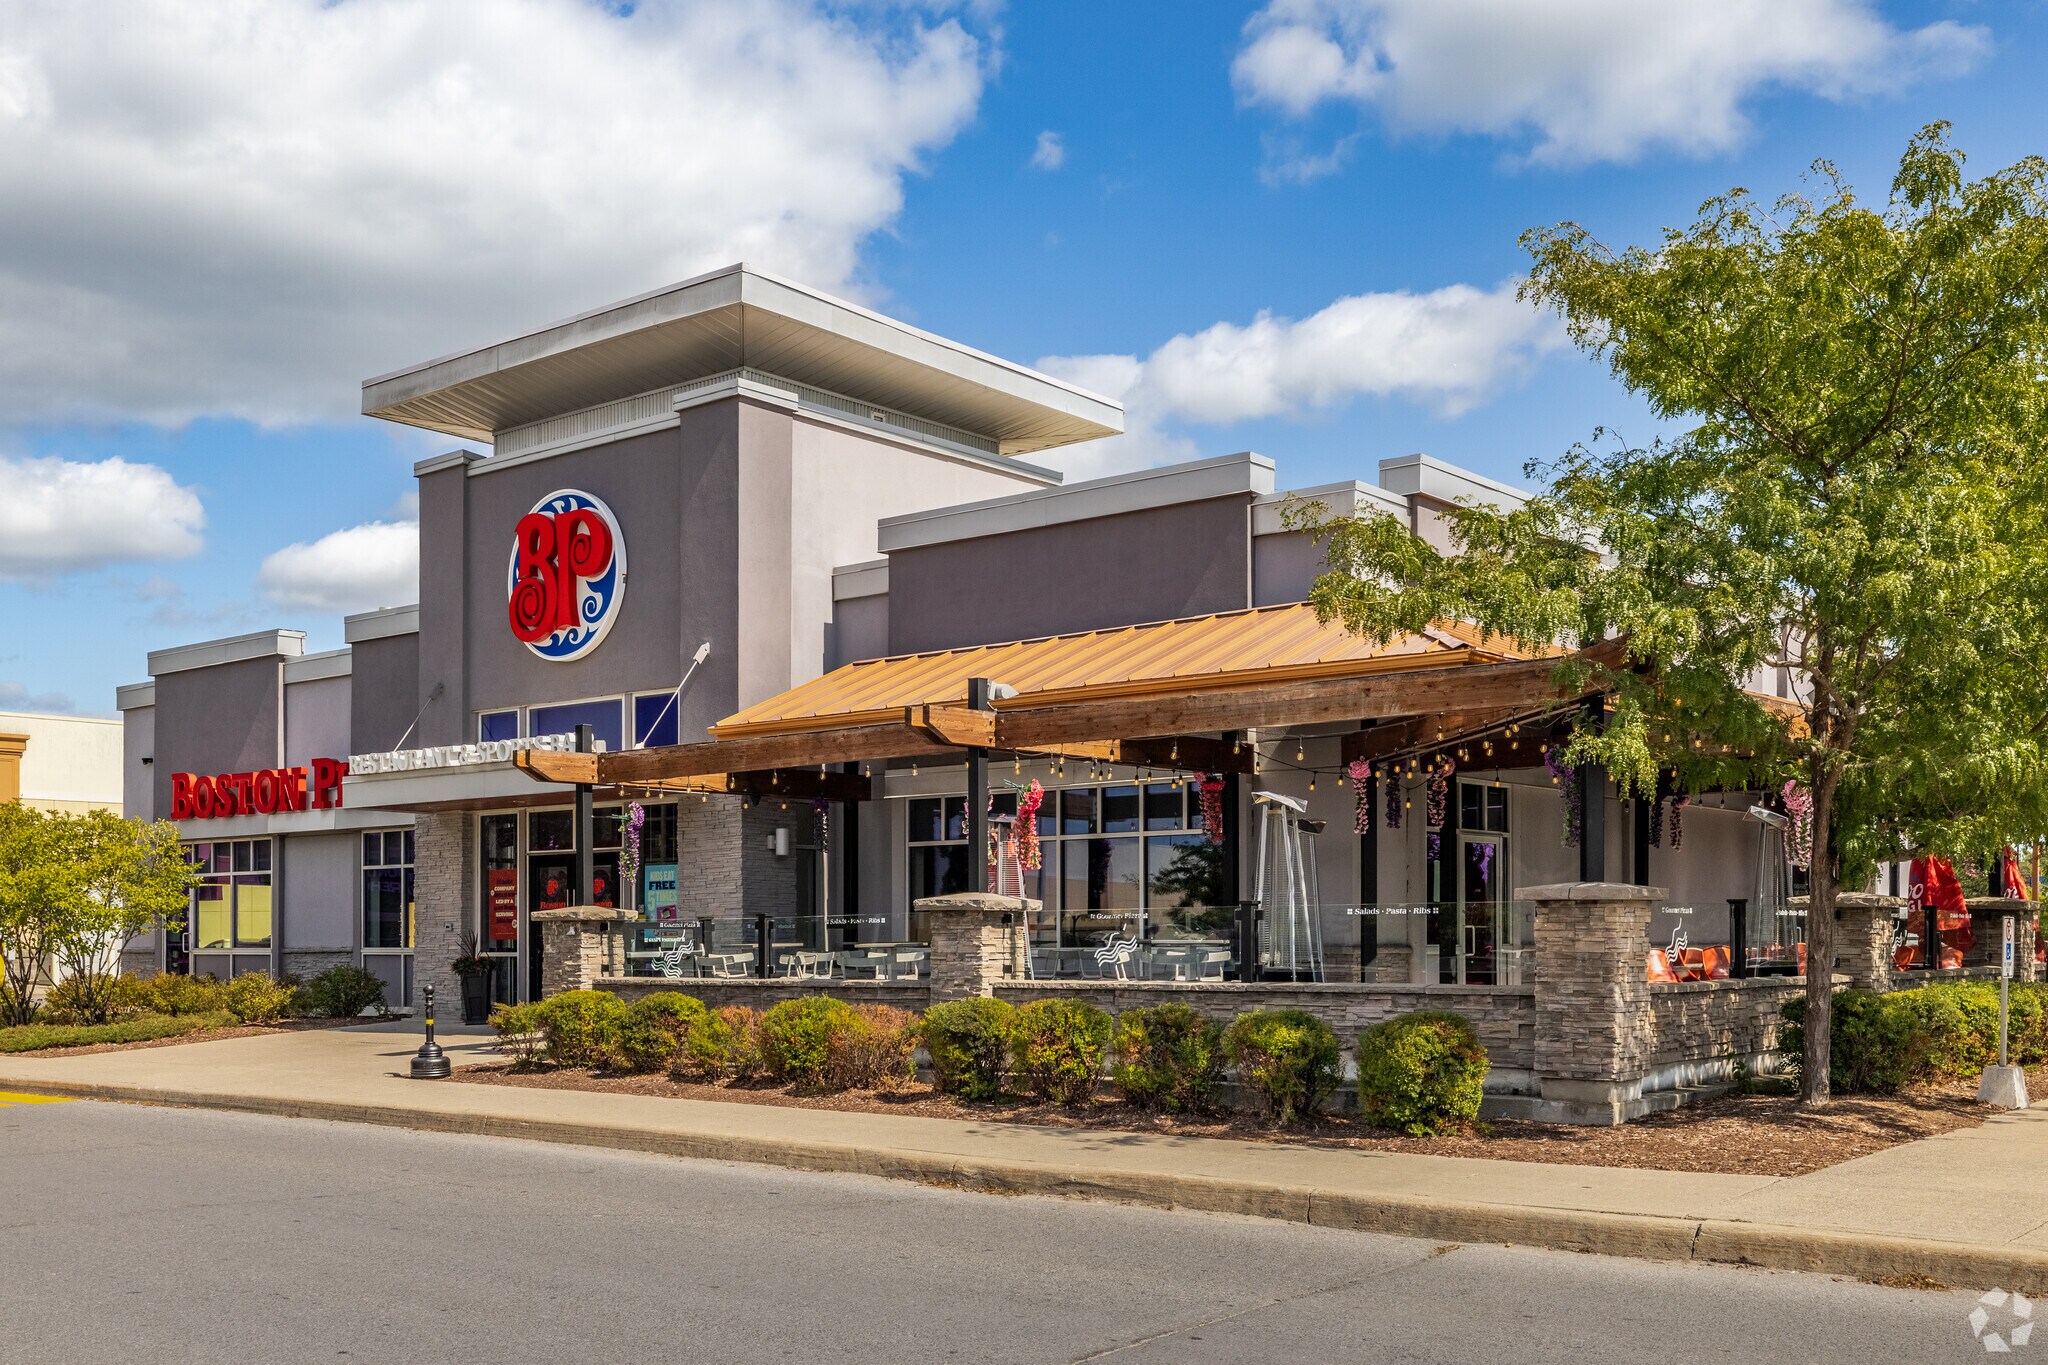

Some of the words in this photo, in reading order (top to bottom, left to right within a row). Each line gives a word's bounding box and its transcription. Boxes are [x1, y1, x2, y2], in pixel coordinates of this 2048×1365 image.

[348, 746, 458, 775] RESTAURANT
[476, 735, 548, 763] SPORTS
[550, 732, 606, 753] BA
[170, 767, 308, 821] BOSTON
[664, 870, 675, 880] EAT
[649, 881, 676, 890] FREE
[647, 890, 656, 912] 5
[1354, 907, 1380, 915] Salads
[1385, 907, 1407, 915] Pasta
